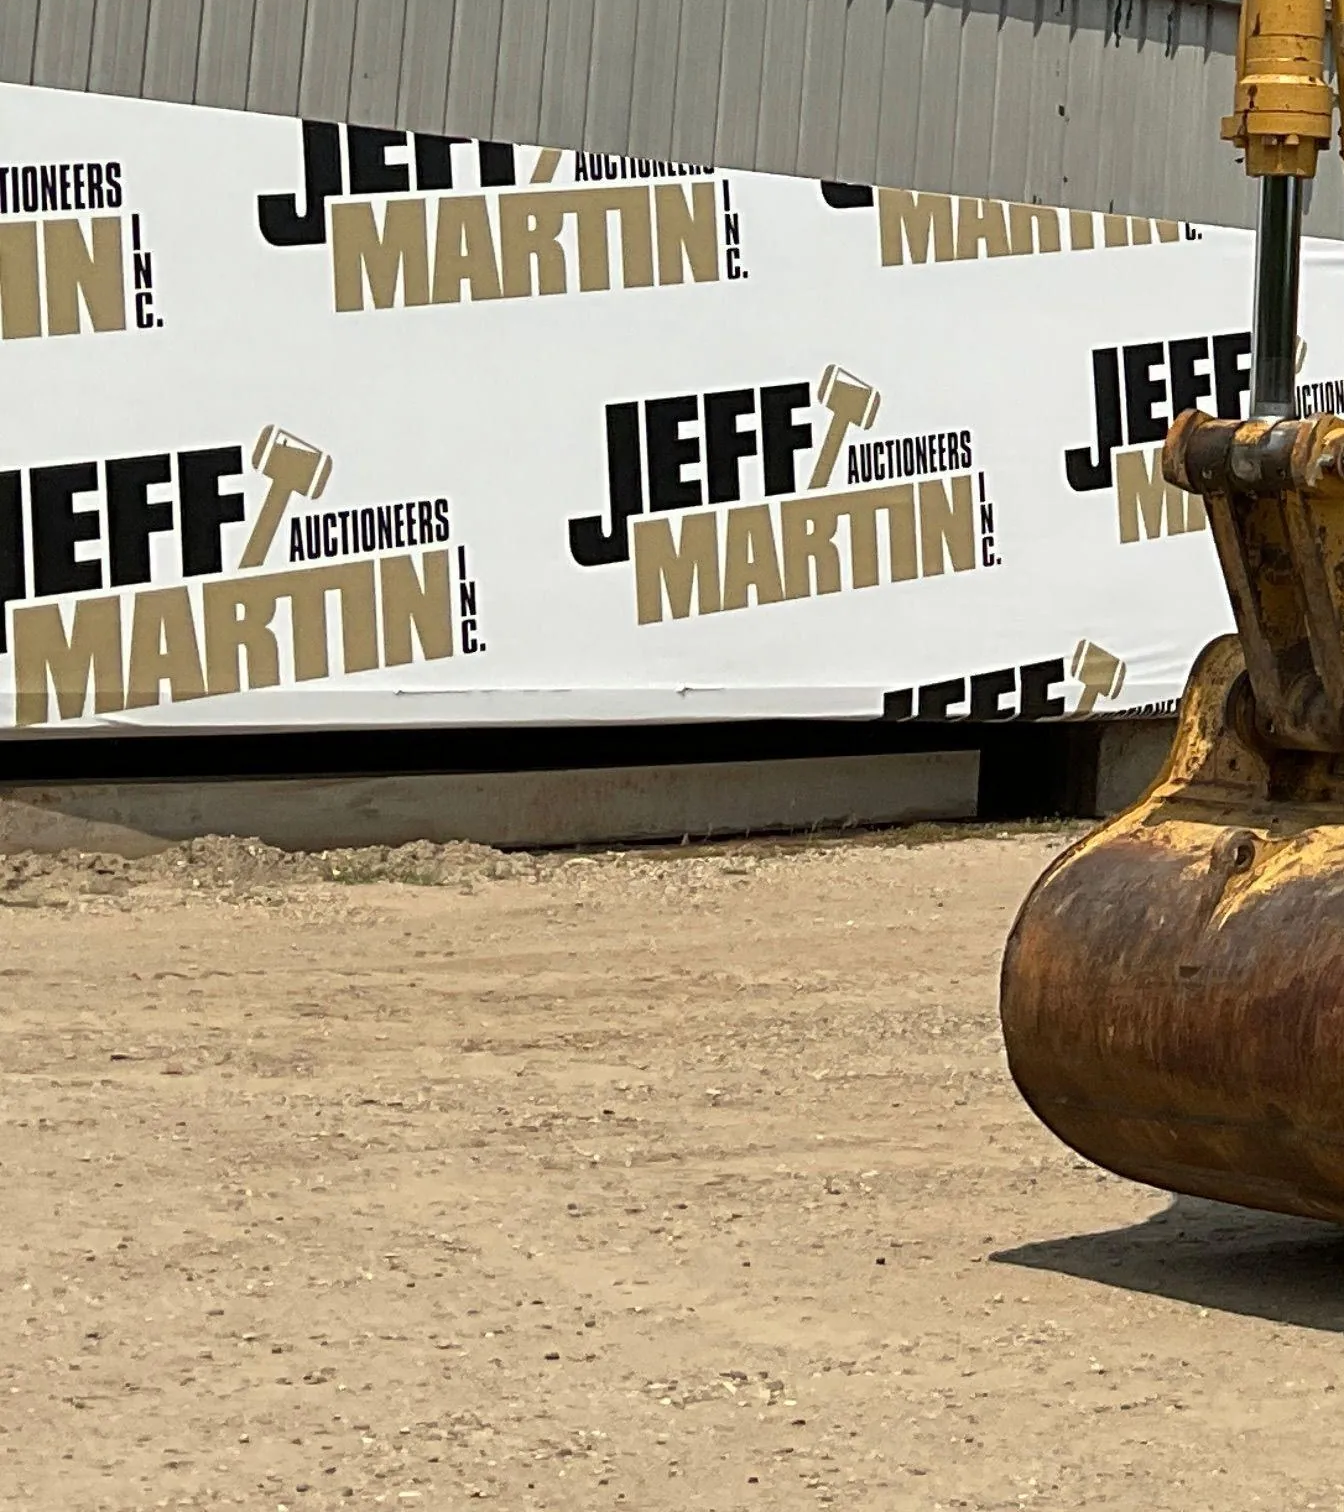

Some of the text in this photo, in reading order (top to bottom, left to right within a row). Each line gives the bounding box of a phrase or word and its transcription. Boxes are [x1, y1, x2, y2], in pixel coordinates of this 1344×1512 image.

[0, 162, 122, 213] TIONEERS
[331, 183, 719, 312] MARTIN
[569, 382, 813, 565] JEFF
[847, 430, 972, 485] AUCTIONEERS
[1065, 332, 1252, 492] JEFF
[289, 498, 450, 562] AUCTIONEERS
[632, 474, 976, 625] MARTIN
[12, 549, 454, 726] MARTIN
